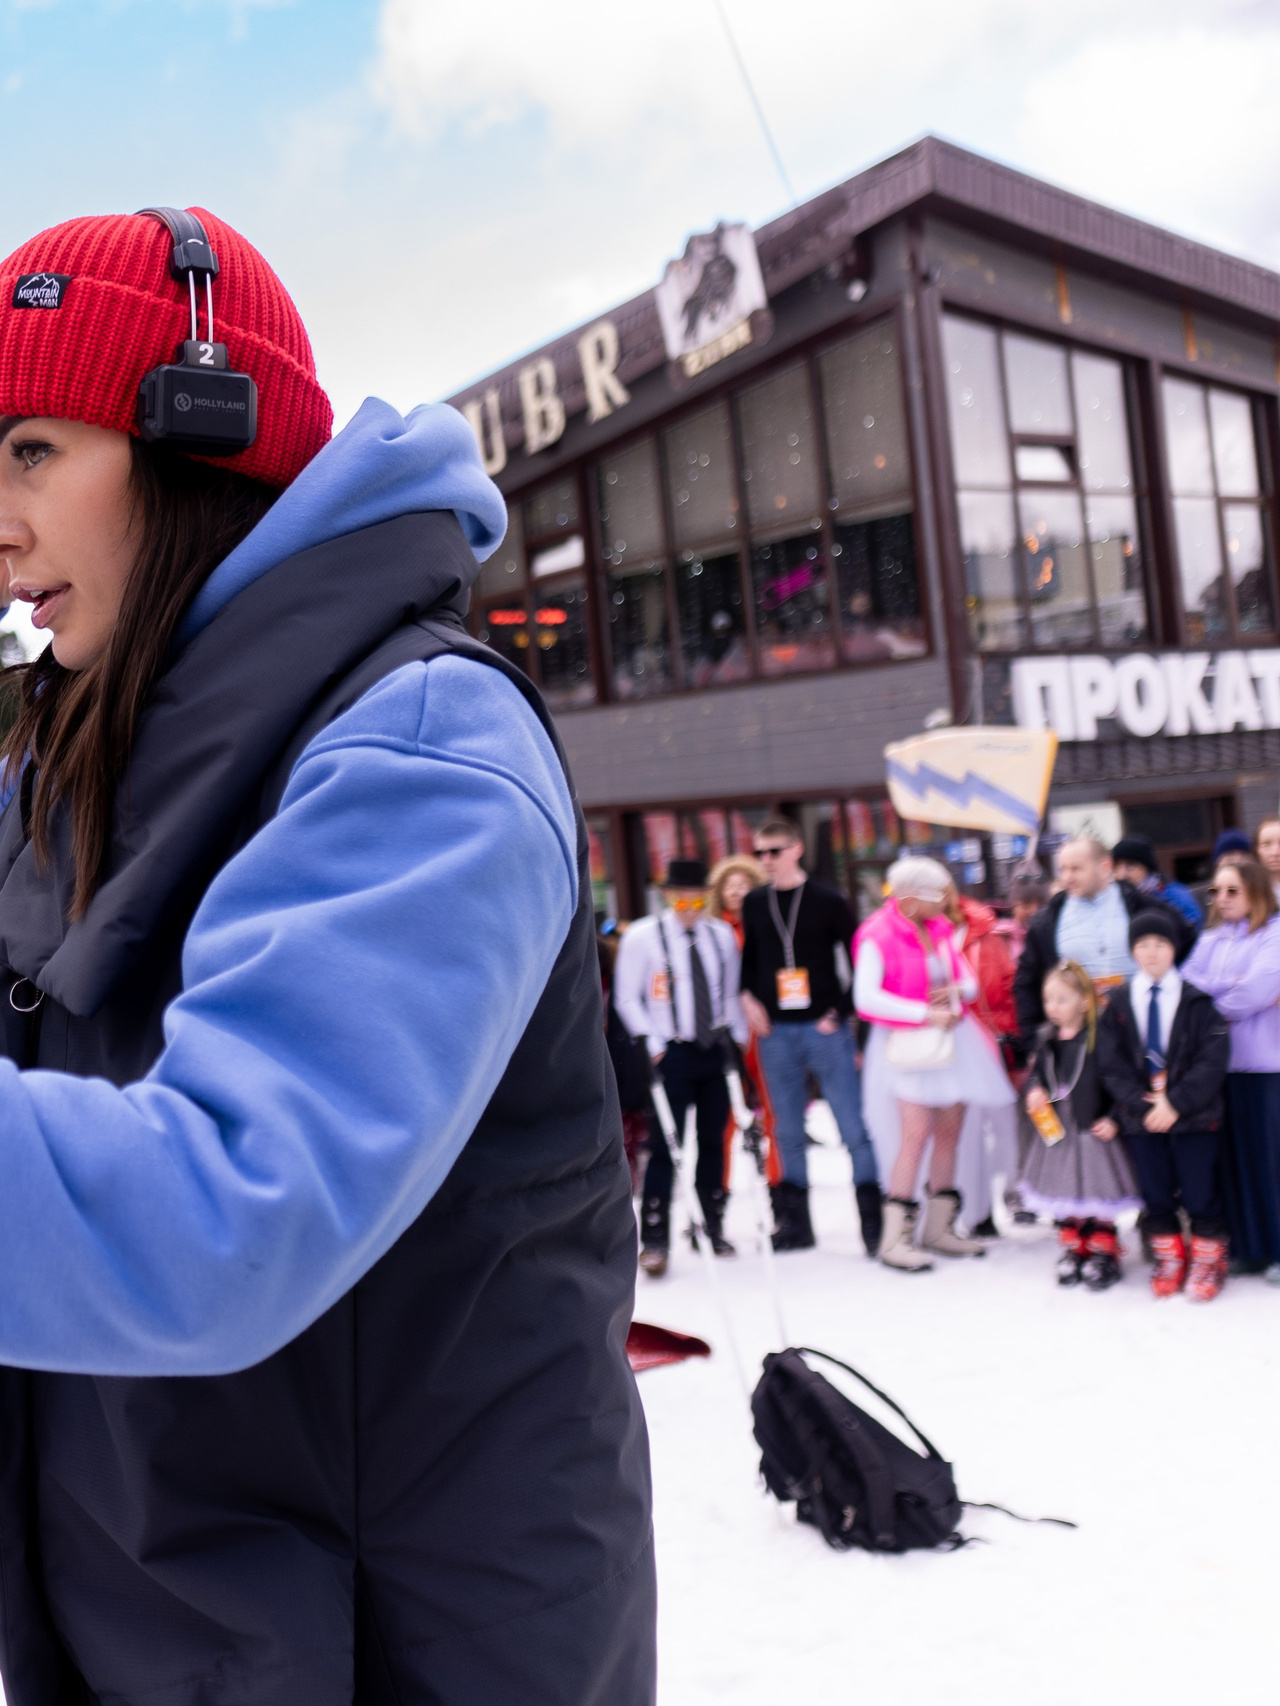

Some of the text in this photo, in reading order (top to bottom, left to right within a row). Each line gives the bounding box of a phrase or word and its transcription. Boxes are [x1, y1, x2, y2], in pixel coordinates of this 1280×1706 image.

[18, 287, 60, 299] MOUNTAIN
[39, 298, 58, 308] MAN
[198, 343, 215, 366] 2
[194, 397, 246, 411] HOLLYLAND
[460, 320, 630, 477] UBR
